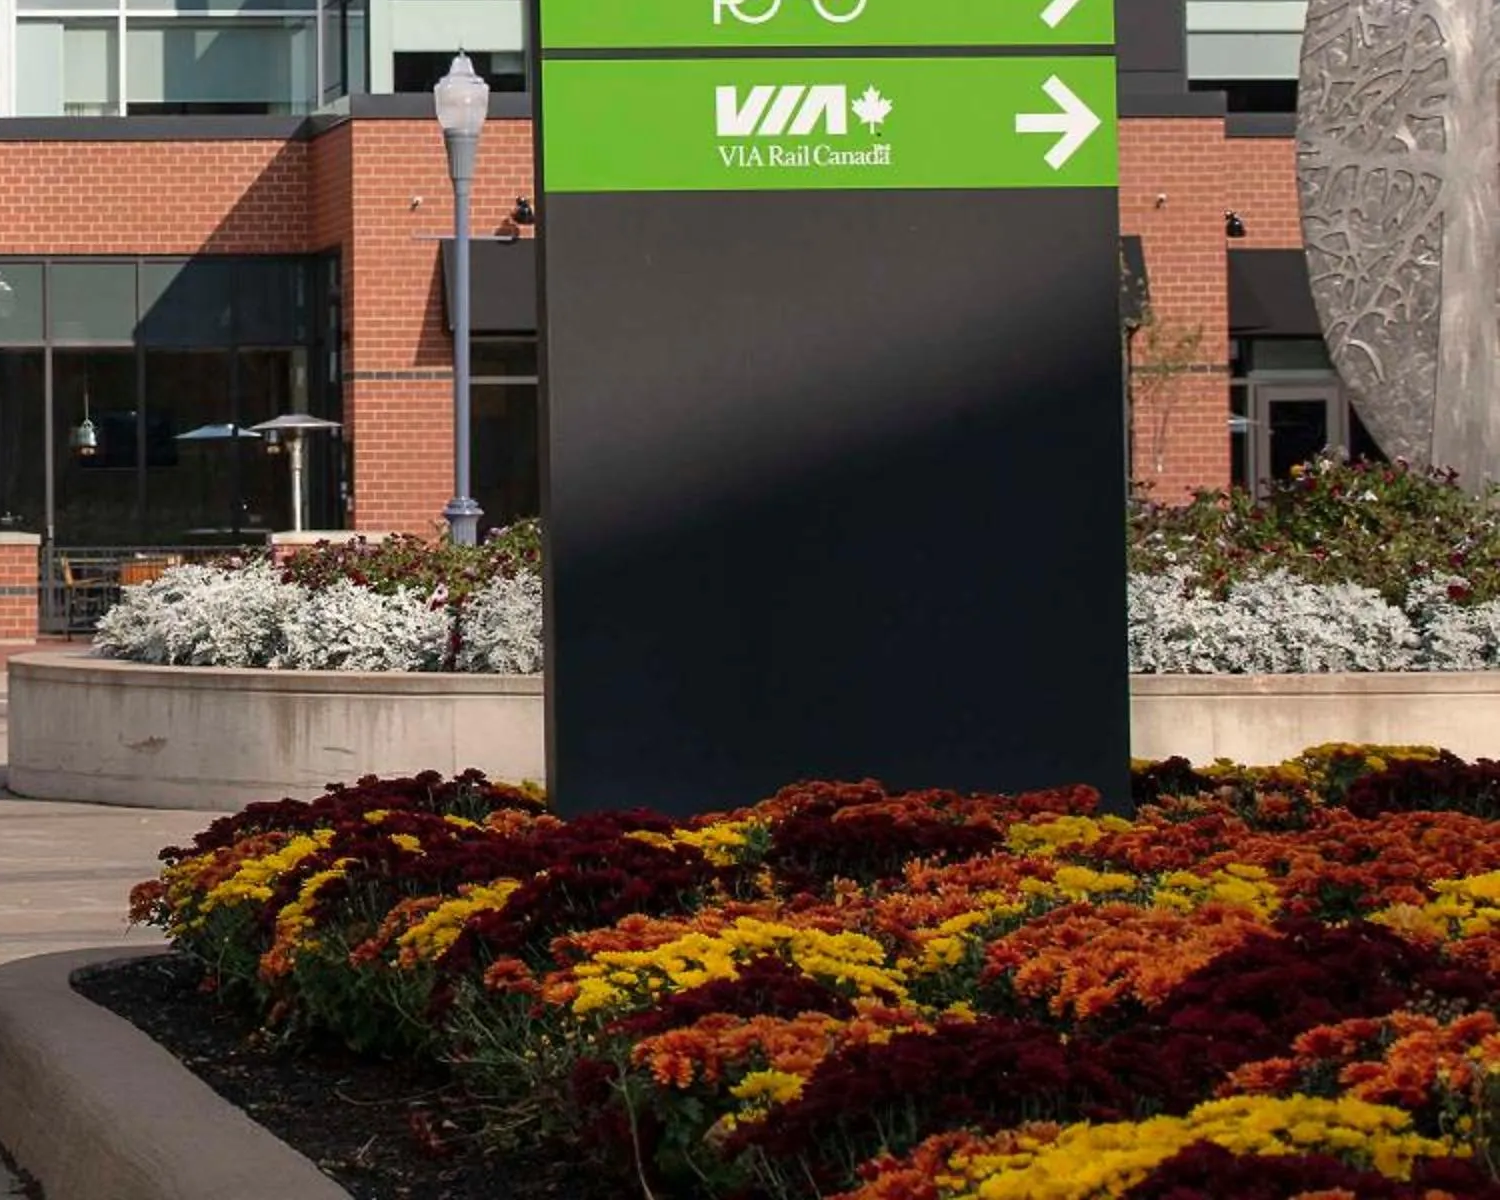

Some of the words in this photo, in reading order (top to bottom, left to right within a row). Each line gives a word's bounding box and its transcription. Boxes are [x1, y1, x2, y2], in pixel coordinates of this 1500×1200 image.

[715, 85, 848, 136] VIA
[717, 146, 764, 167] VIA
[769, 145, 810, 167] Rail
[813, 144, 892, 166] Canada
